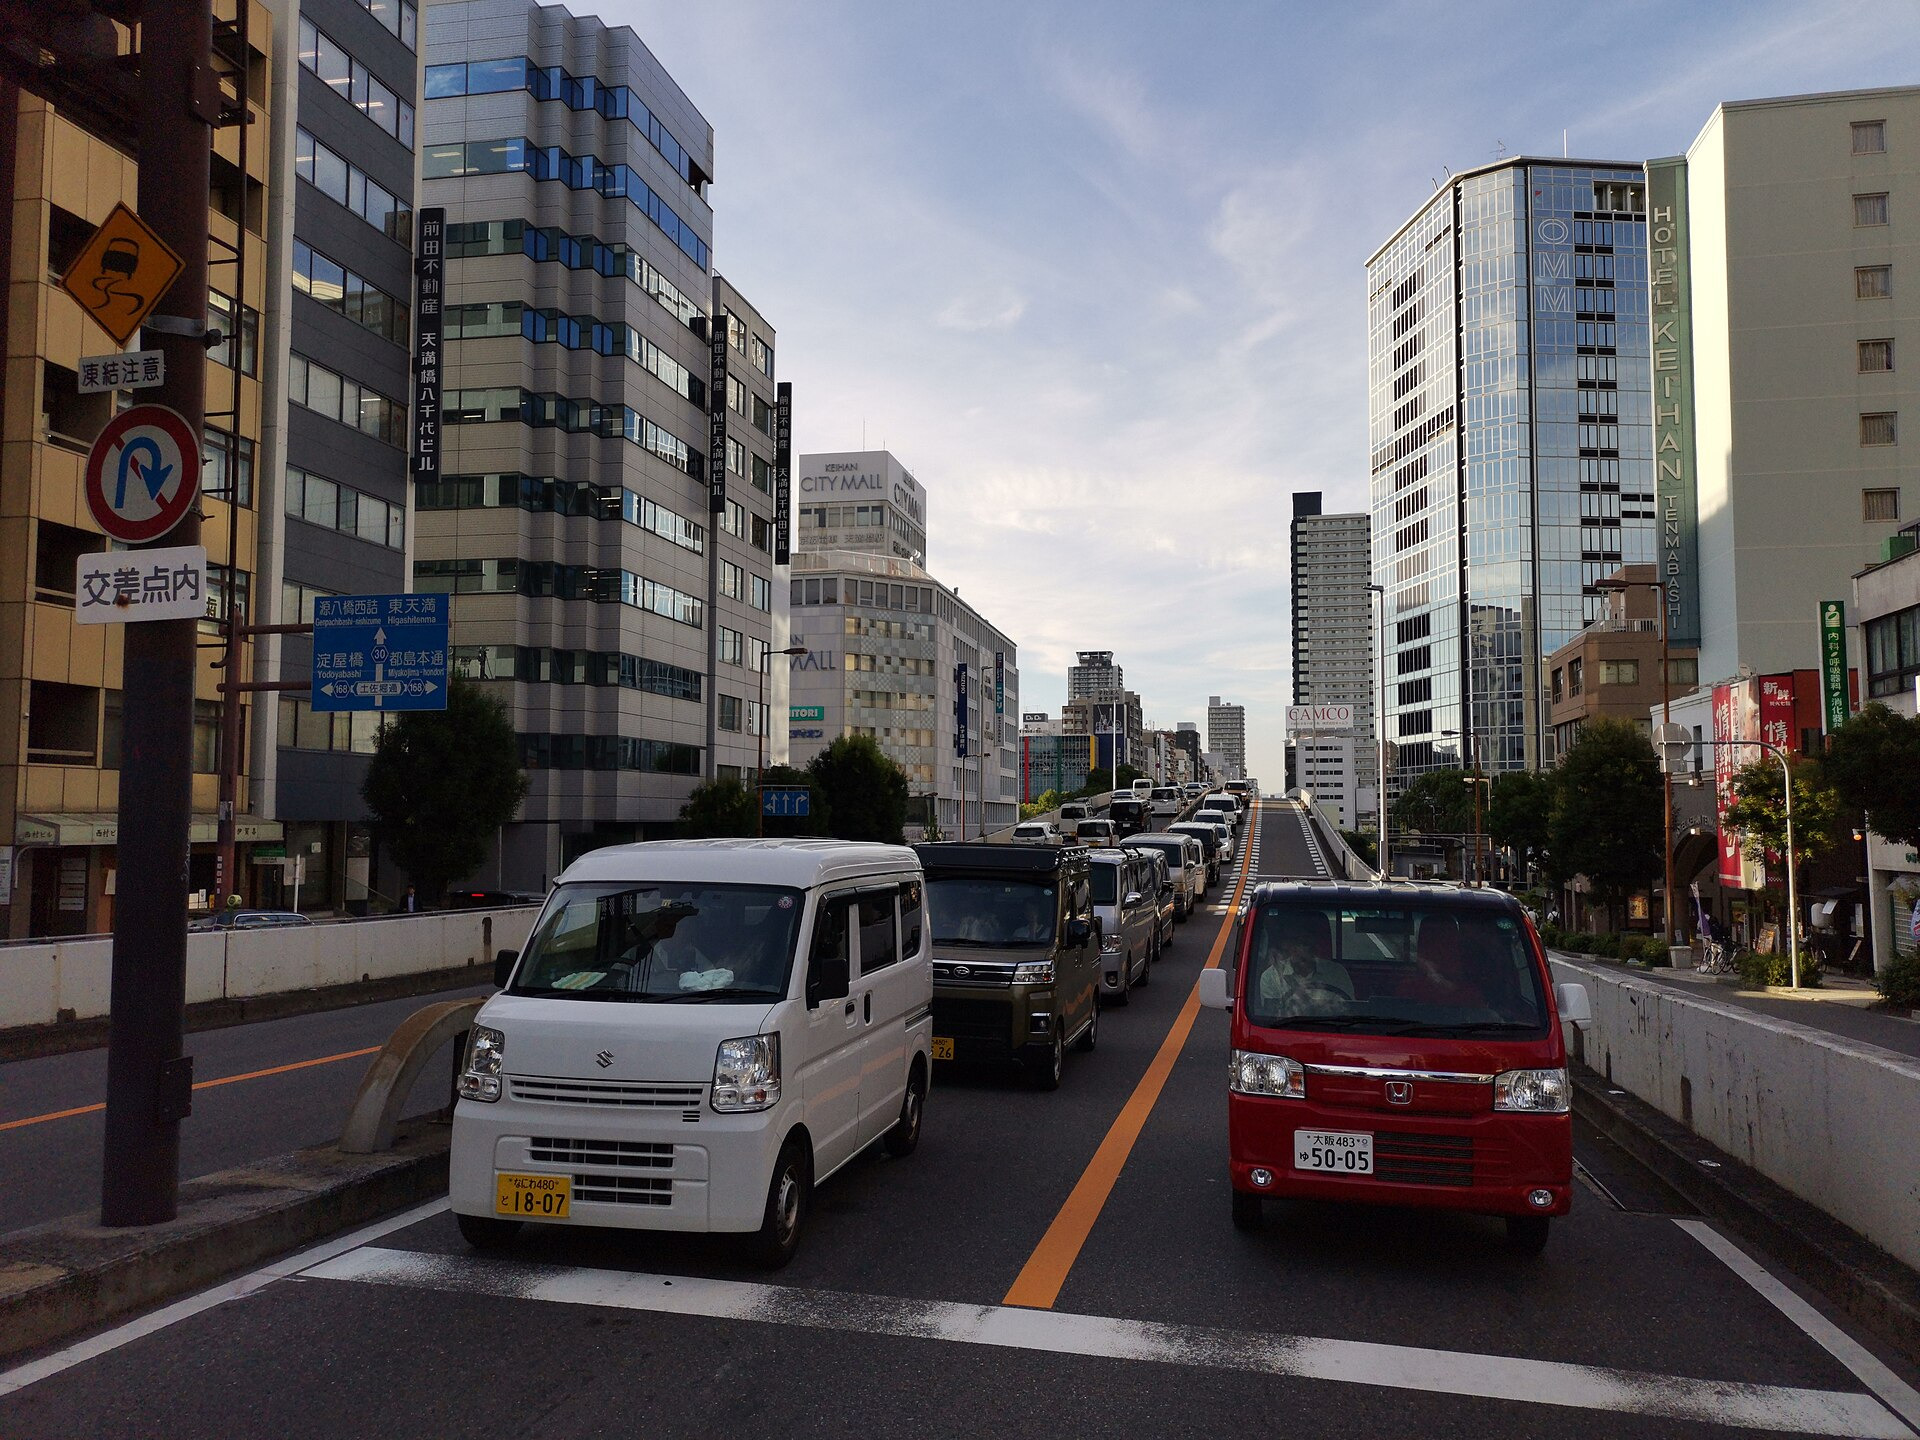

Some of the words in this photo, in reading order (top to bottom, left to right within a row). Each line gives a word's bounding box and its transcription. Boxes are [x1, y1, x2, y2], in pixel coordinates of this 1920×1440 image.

[1653, 206, 1674, 306] HOTEL
[420, 219, 440, 315] 前田不動産
[1537, 218, 1570, 313] OMM
[713, 330, 725, 392] 前田不動産
[81, 356, 161, 388] 凍結注意
[417, 332, 437, 473] 天満橋八千代ビル
[1653, 321, 1682, 481] KEIHAN
[778, 395, 789, 450] 前田不動産
[711, 411, 725, 497] MF天満橋ビル
[825, 462, 858, 473] KEIHAN
[800, 475, 838, 492] CITY
[840, 473, 883, 490] MALL
[1663, 495, 1681, 629] TENMABASHI
[82, 563, 200, 608] 交差点内
[319, 600, 379, 616] 源八橋西詰
[388, 598, 437, 614] 東天満
[387, 616, 437, 626] Higashitenma
[1828, 632, 1840, 650] 内科
[316, 652, 364, 669] 淀屋橋
[374, 649, 386, 660] 30
[389, 650, 444, 667] 都島本通
[317, 670, 362, 680] Yodoyabashi
[1829, 657, 1841, 690] 呼吸器科
[335, 684, 348, 694] 168
[409, 682, 422, 692] 168
[1763, 681, 1789, 700] 新鮮
[789, 708, 818, 717] ITORI
[1289, 707, 1349, 720] CAMCO
[24, 830, 53, 839] 西村ビル
[95, 829, 116, 838] 西村ビ
[938, 1046, 952, 1058] 26
[1313, 1135, 1356, 1148] 大阪483
[1311, 1147, 1369, 1171] 50-05
[513, 1178, 555, 1191] なにわ480
[501, 1195, 509, 1206] と
[514, 1191, 566, 1215] 18-07
